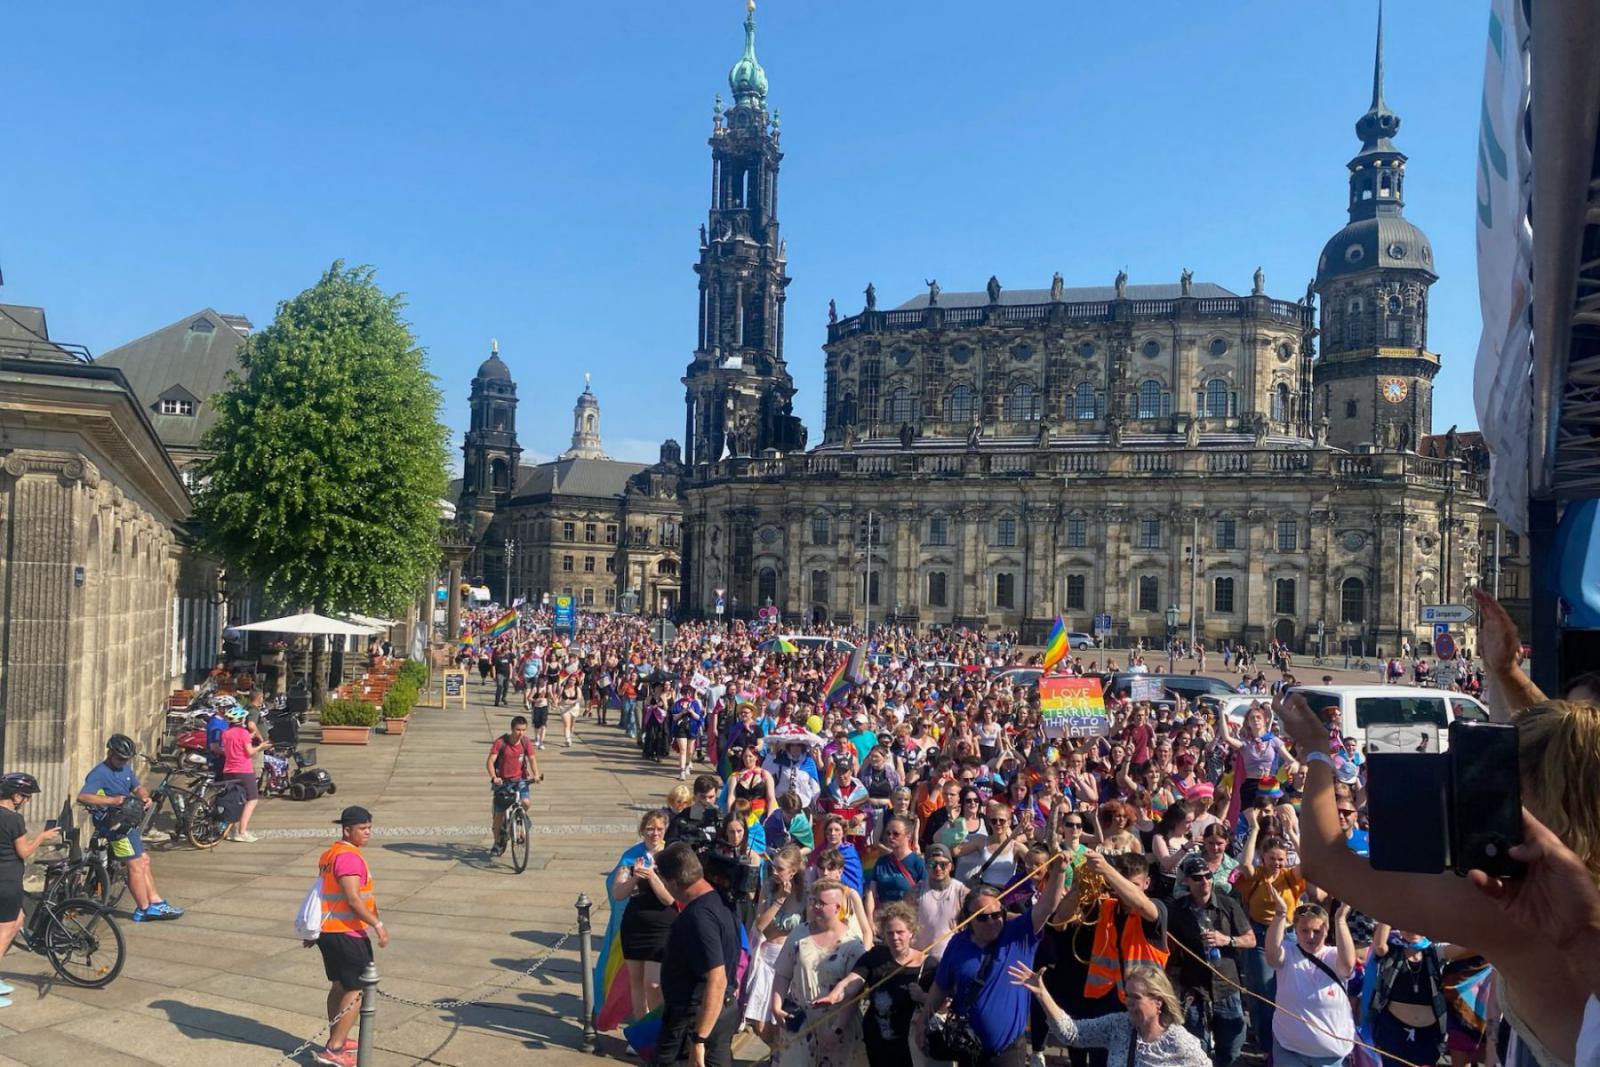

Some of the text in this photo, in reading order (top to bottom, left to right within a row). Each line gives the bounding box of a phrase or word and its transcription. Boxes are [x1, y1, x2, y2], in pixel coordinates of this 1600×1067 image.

[1052, 687, 1090, 699] LOVE
[1058, 697, 1089, 708] IS A
[1046, 707, 1105, 718] TERRIBLE
[1044, 716, 1099, 727] THING TO
